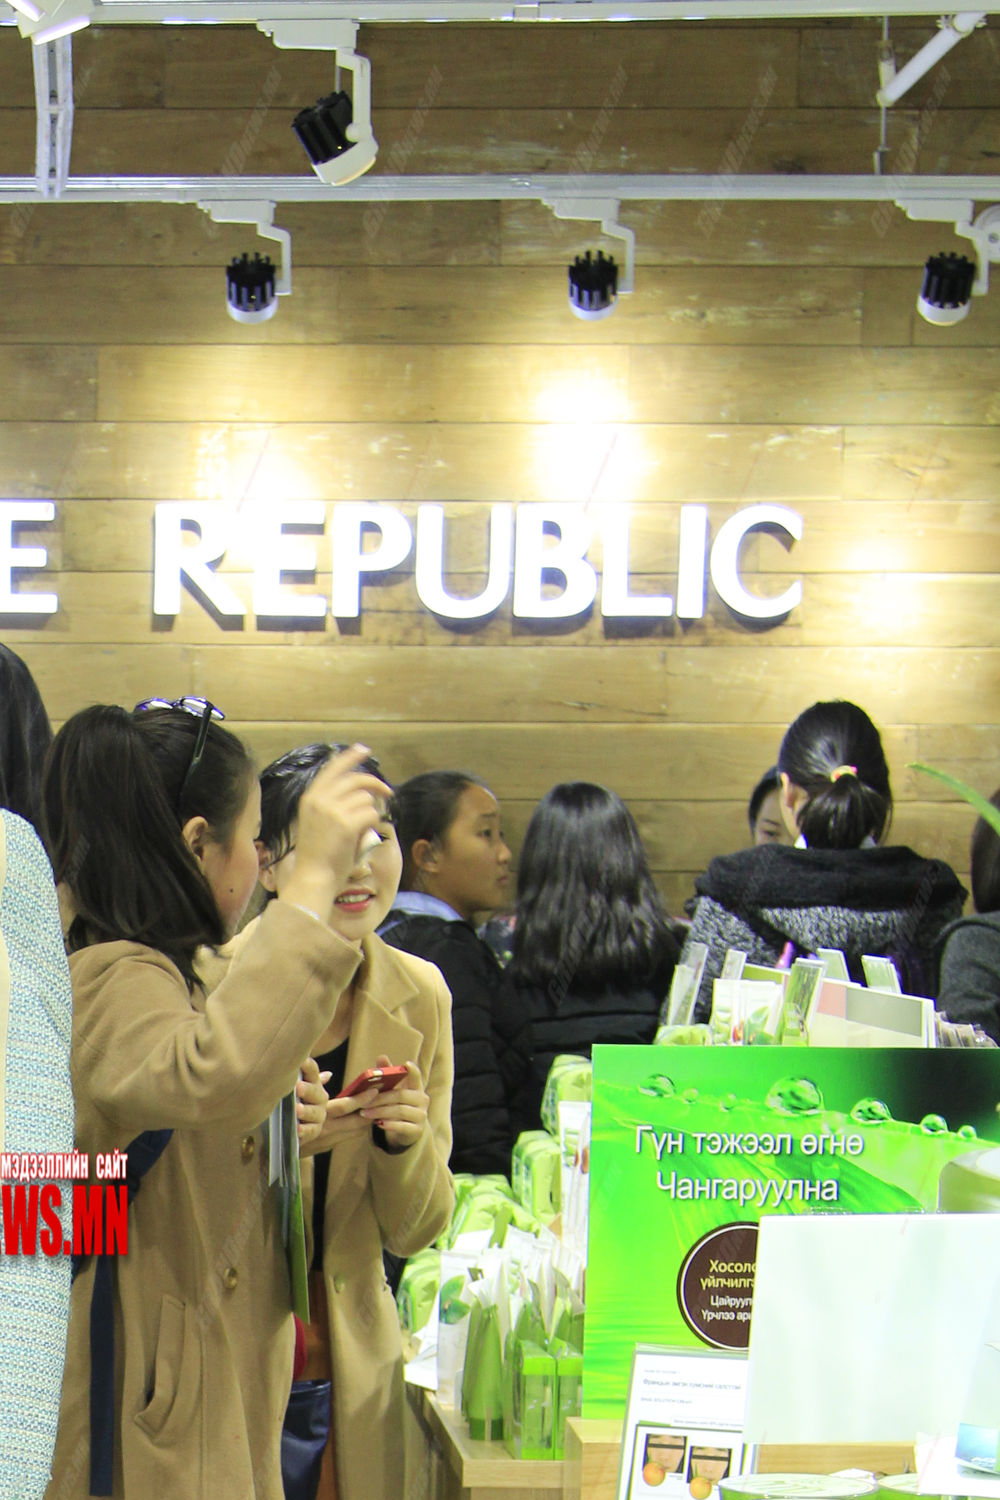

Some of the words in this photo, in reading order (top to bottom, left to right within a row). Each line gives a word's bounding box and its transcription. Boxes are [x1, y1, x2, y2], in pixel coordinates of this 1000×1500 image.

[153, 502, 801, 618] REPUBLIC
[635, 1125, 684, 1160] Гүн
[692, 1132, 792, 1154] тэжээл
[800, 1133, 864, 1155] өгнө
[656, 1171, 839, 1207] Чангаруулна
